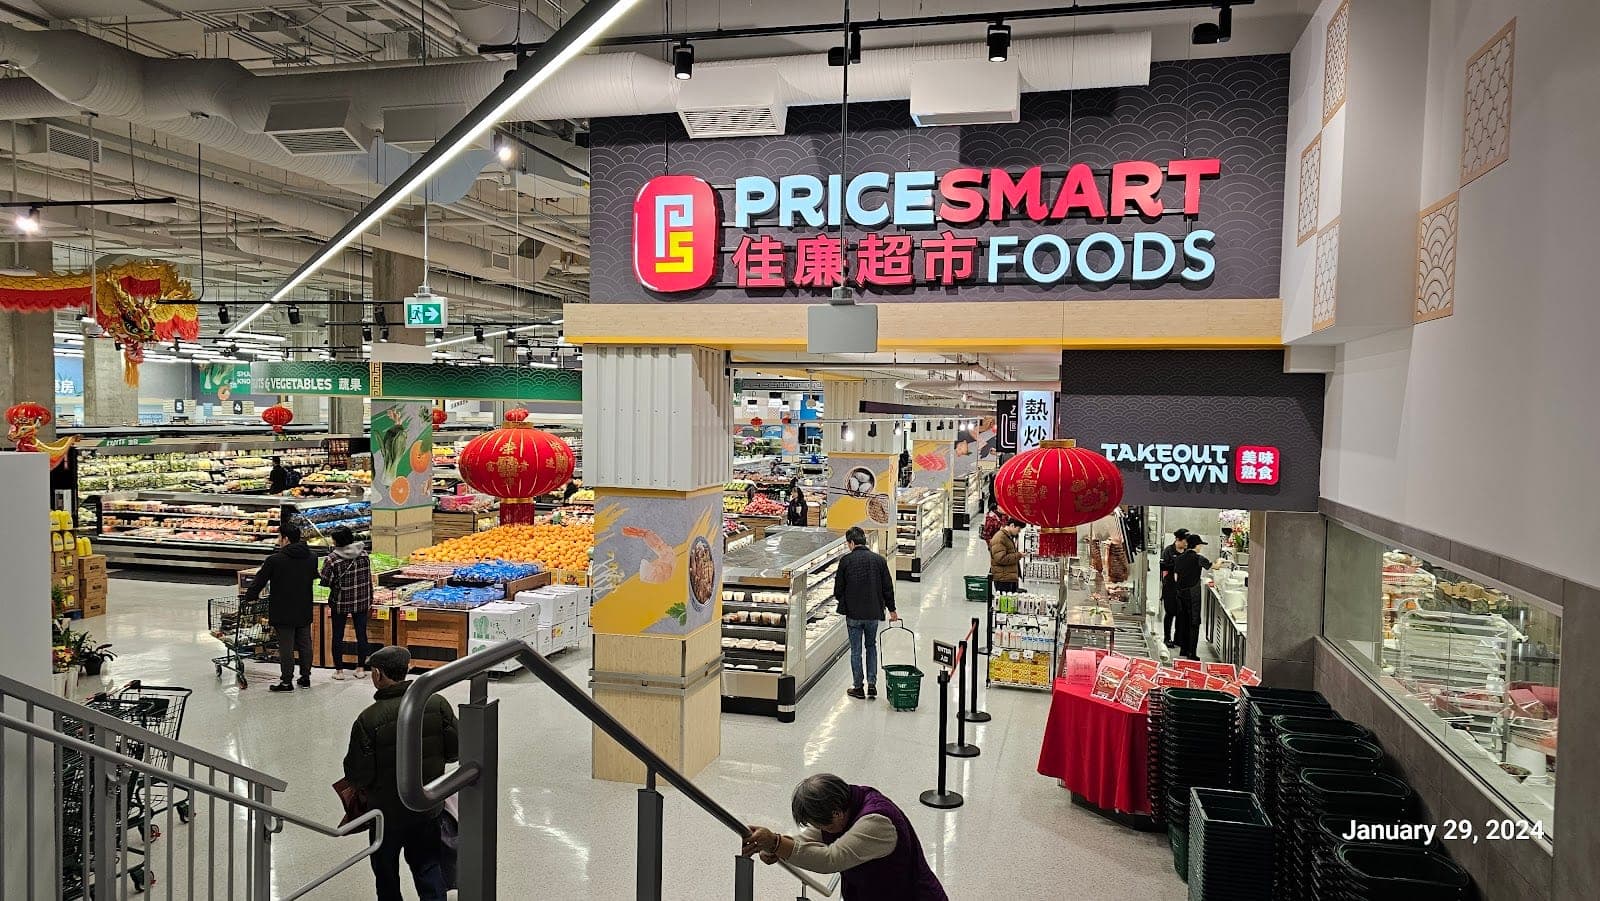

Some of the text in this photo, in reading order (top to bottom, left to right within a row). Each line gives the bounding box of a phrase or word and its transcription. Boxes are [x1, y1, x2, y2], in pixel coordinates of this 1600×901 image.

[734, 159, 1221, 228] PRICESMART
[731, 230, 1217, 288] 佳廉超市 FOODS
[271, 378, 332, 391] VEGETABLES
[176, 402, 183, 410] 5
[234, 404, 242, 412] 4
[1024, 398, 1049, 447] 熱炒
[1100, 443, 1230, 464] TAKEOUT
[1241, 450, 1275, 465] 美味
[1144, 463, 1229, 483] TOWN
